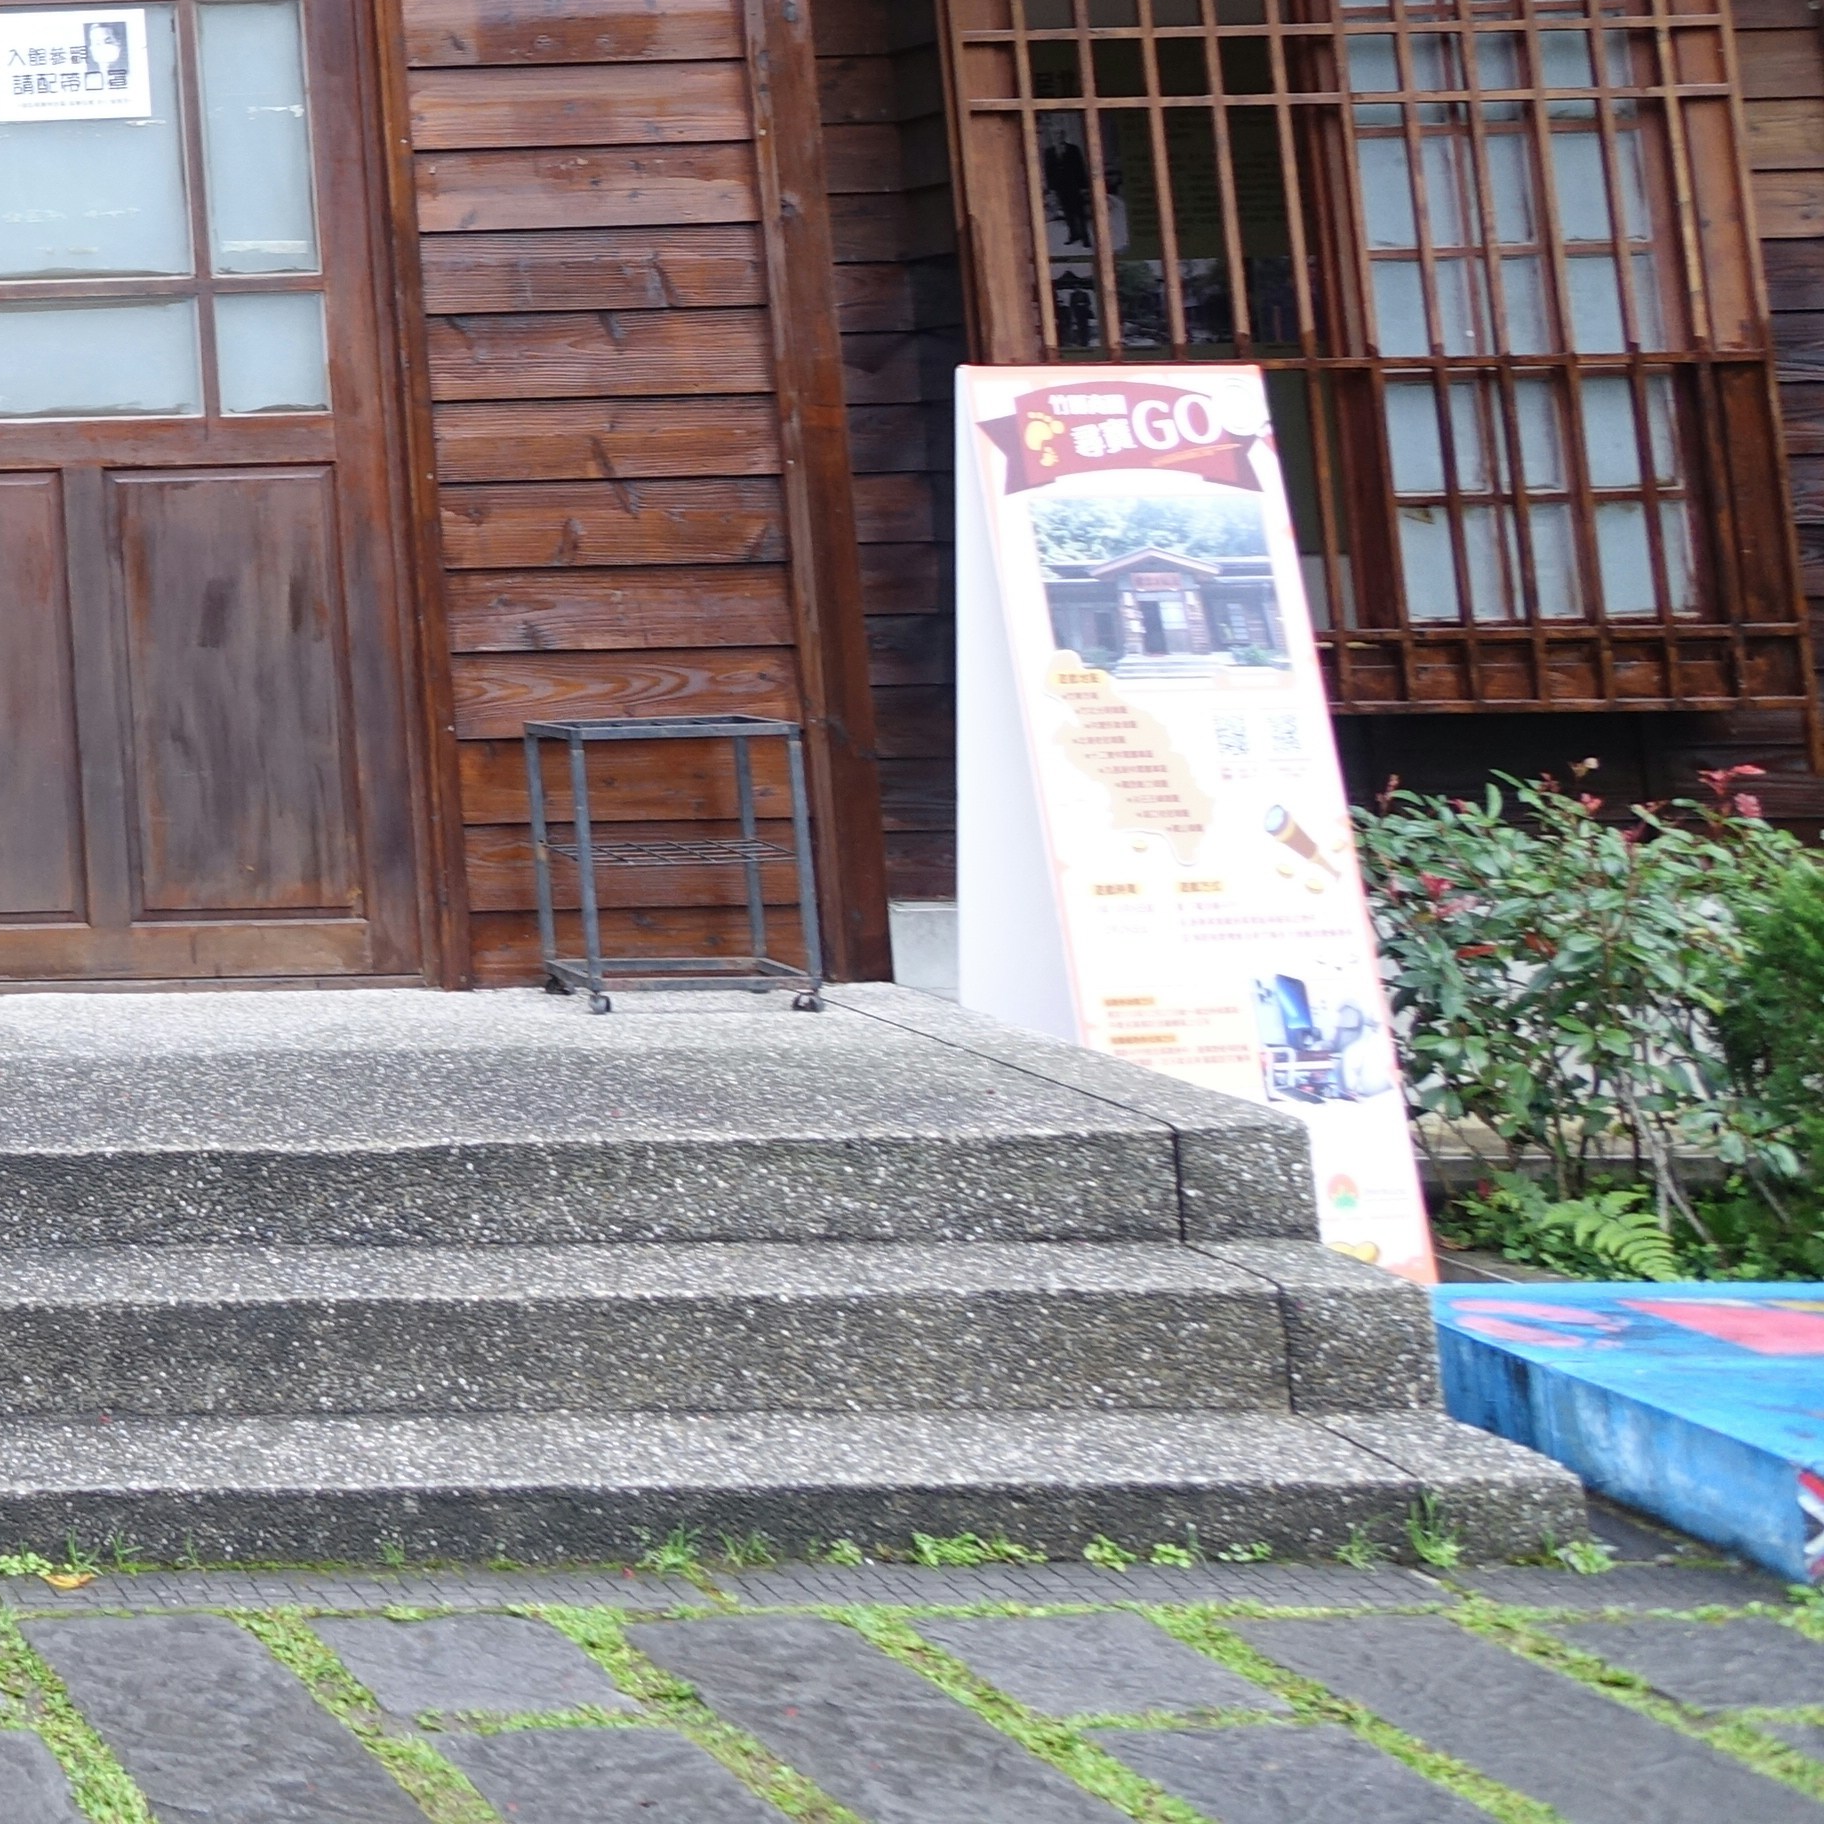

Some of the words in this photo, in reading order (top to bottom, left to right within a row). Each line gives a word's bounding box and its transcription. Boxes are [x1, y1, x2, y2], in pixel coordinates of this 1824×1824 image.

[12, 68, 128, 95] 請配帶口罩
